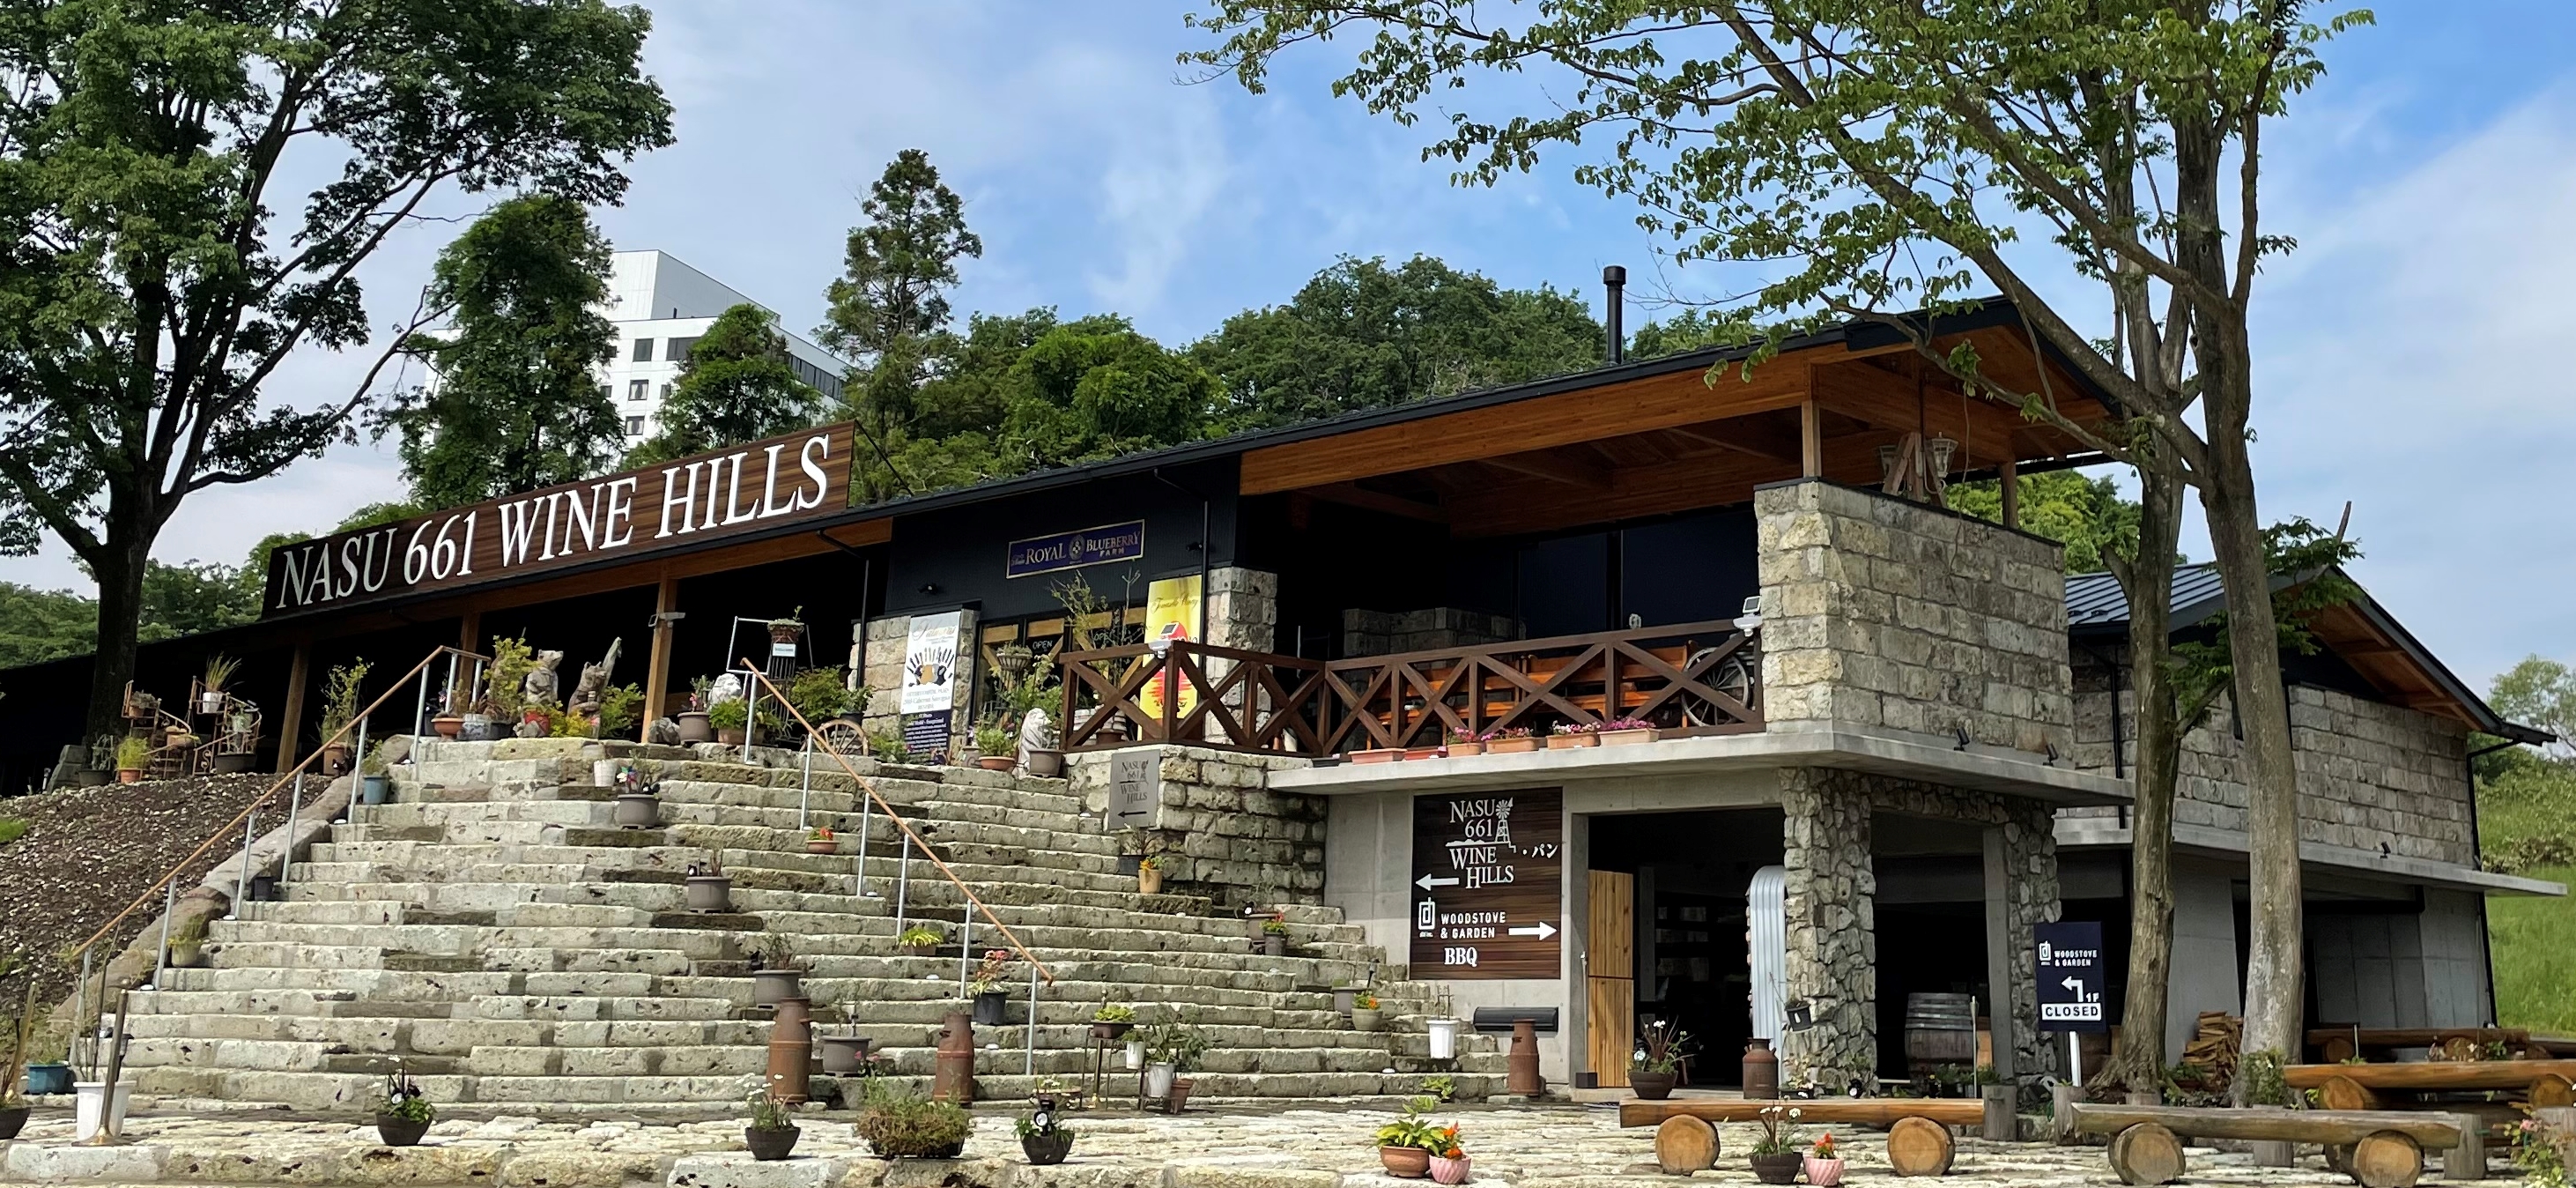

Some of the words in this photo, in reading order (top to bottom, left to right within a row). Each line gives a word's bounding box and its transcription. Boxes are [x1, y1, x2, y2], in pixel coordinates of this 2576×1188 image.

[276, 528, 396, 609] NASU
[403, 510, 476, 584] 661
[499, 476, 637, 568] WINE
[655, 434, 830, 538] HILLS
[1086, 531, 1139, 553] BLUEBERRY
[1025, 542, 1067, 565] ROYAL
[1099, 546, 1125, 557] FARM
[1032, 640, 1054, 650] OPEN
[1128, 770, 1140, 779] 661
[1120, 783, 1141, 795] WINE
[1126, 792, 1148, 805] HILLS
[1448, 798, 1495, 823] NASU
[1464, 819, 1493, 837] 661
[1449, 846, 1498, 870] WINE
[1465, 865, 1514, 889] HILLS
[1440, 911, 1507, 924] WOODSTOVE
[1440, 928, 1448, 939] &
[1452, 927, 1496, 939] GARDEN
[1444, 947, 1477, 967] BBQ
[2054, 949, 2098, 958] WOODSTOVE
[2062, 958, 2091, 967] GARDEN
[2085, 992, 2099, 1003] 1F
[2045, 1006, 2099, 1017] CLOSED
